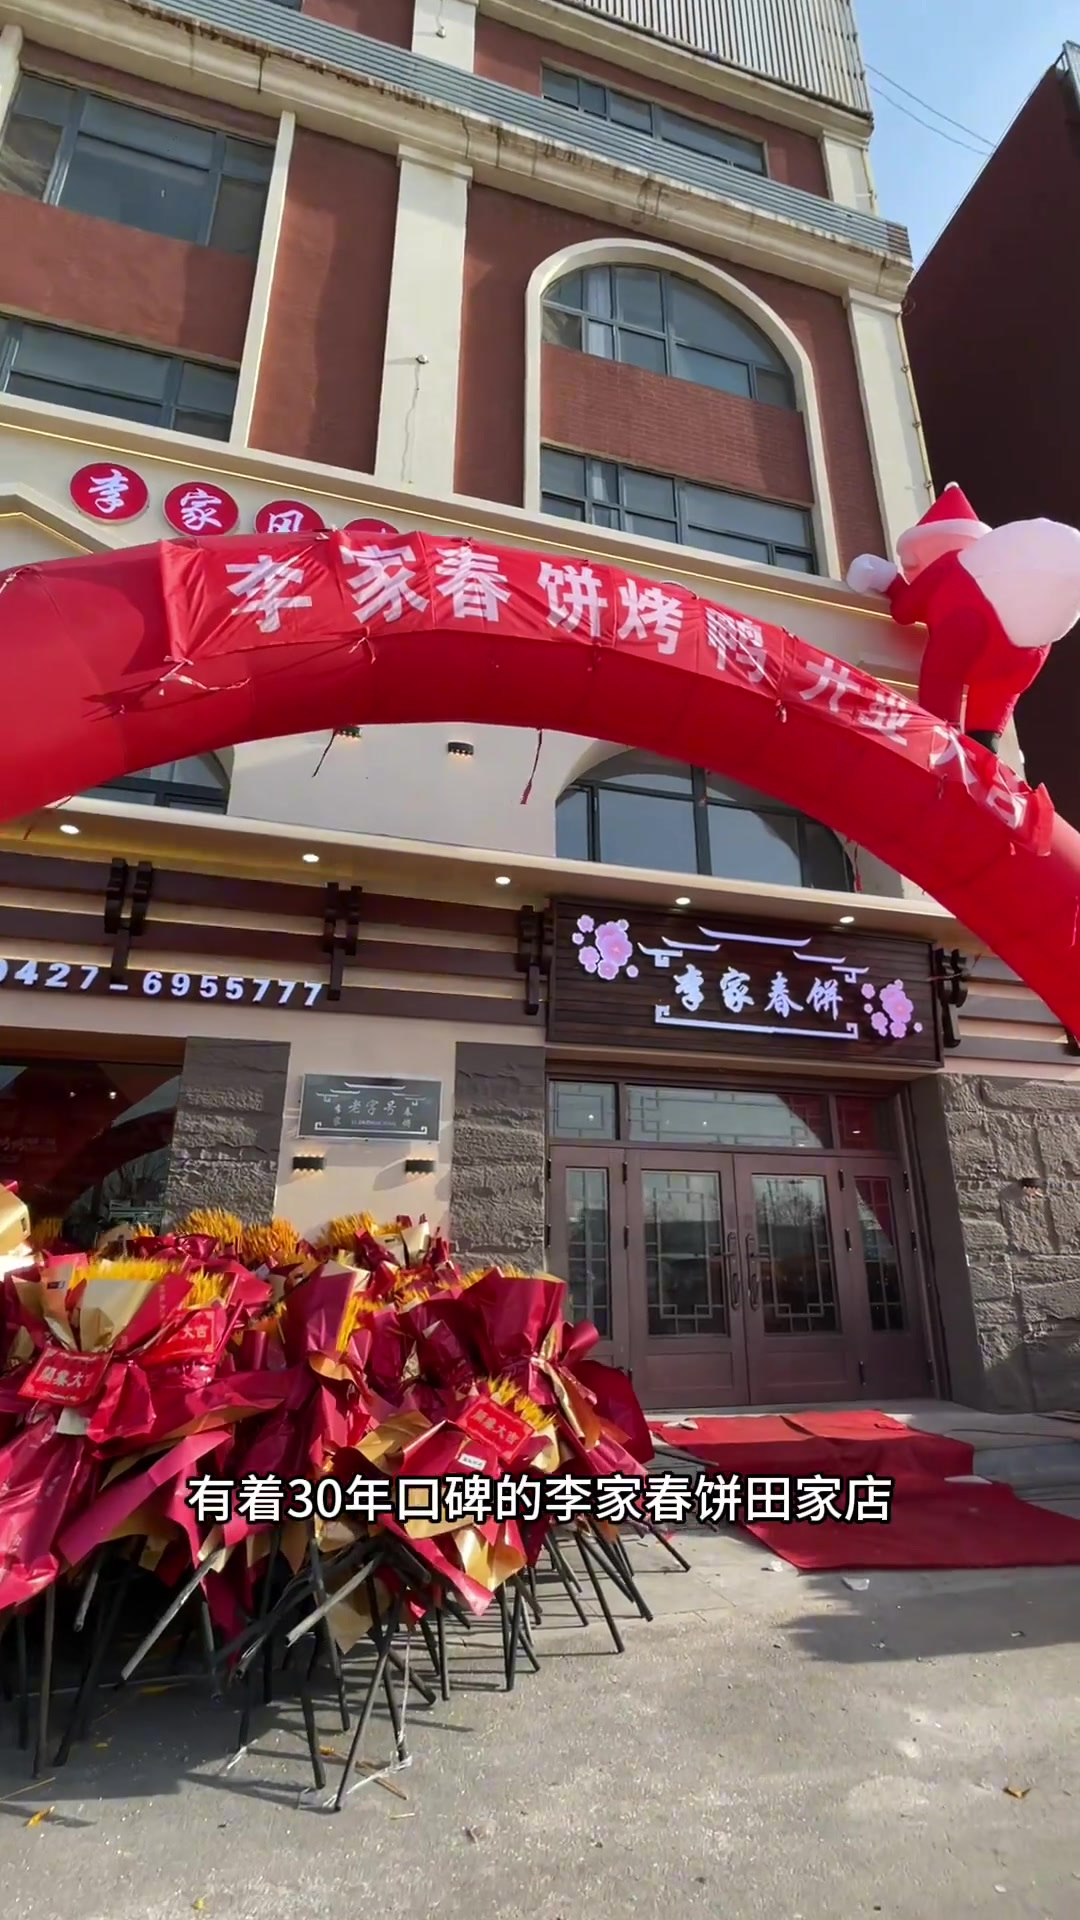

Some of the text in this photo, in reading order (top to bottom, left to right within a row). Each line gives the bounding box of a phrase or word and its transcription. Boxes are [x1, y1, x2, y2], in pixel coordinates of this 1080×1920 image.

[673, 963, 843, 1021] 李家春饼
[348, 1099, 397, 1116] 老字号
